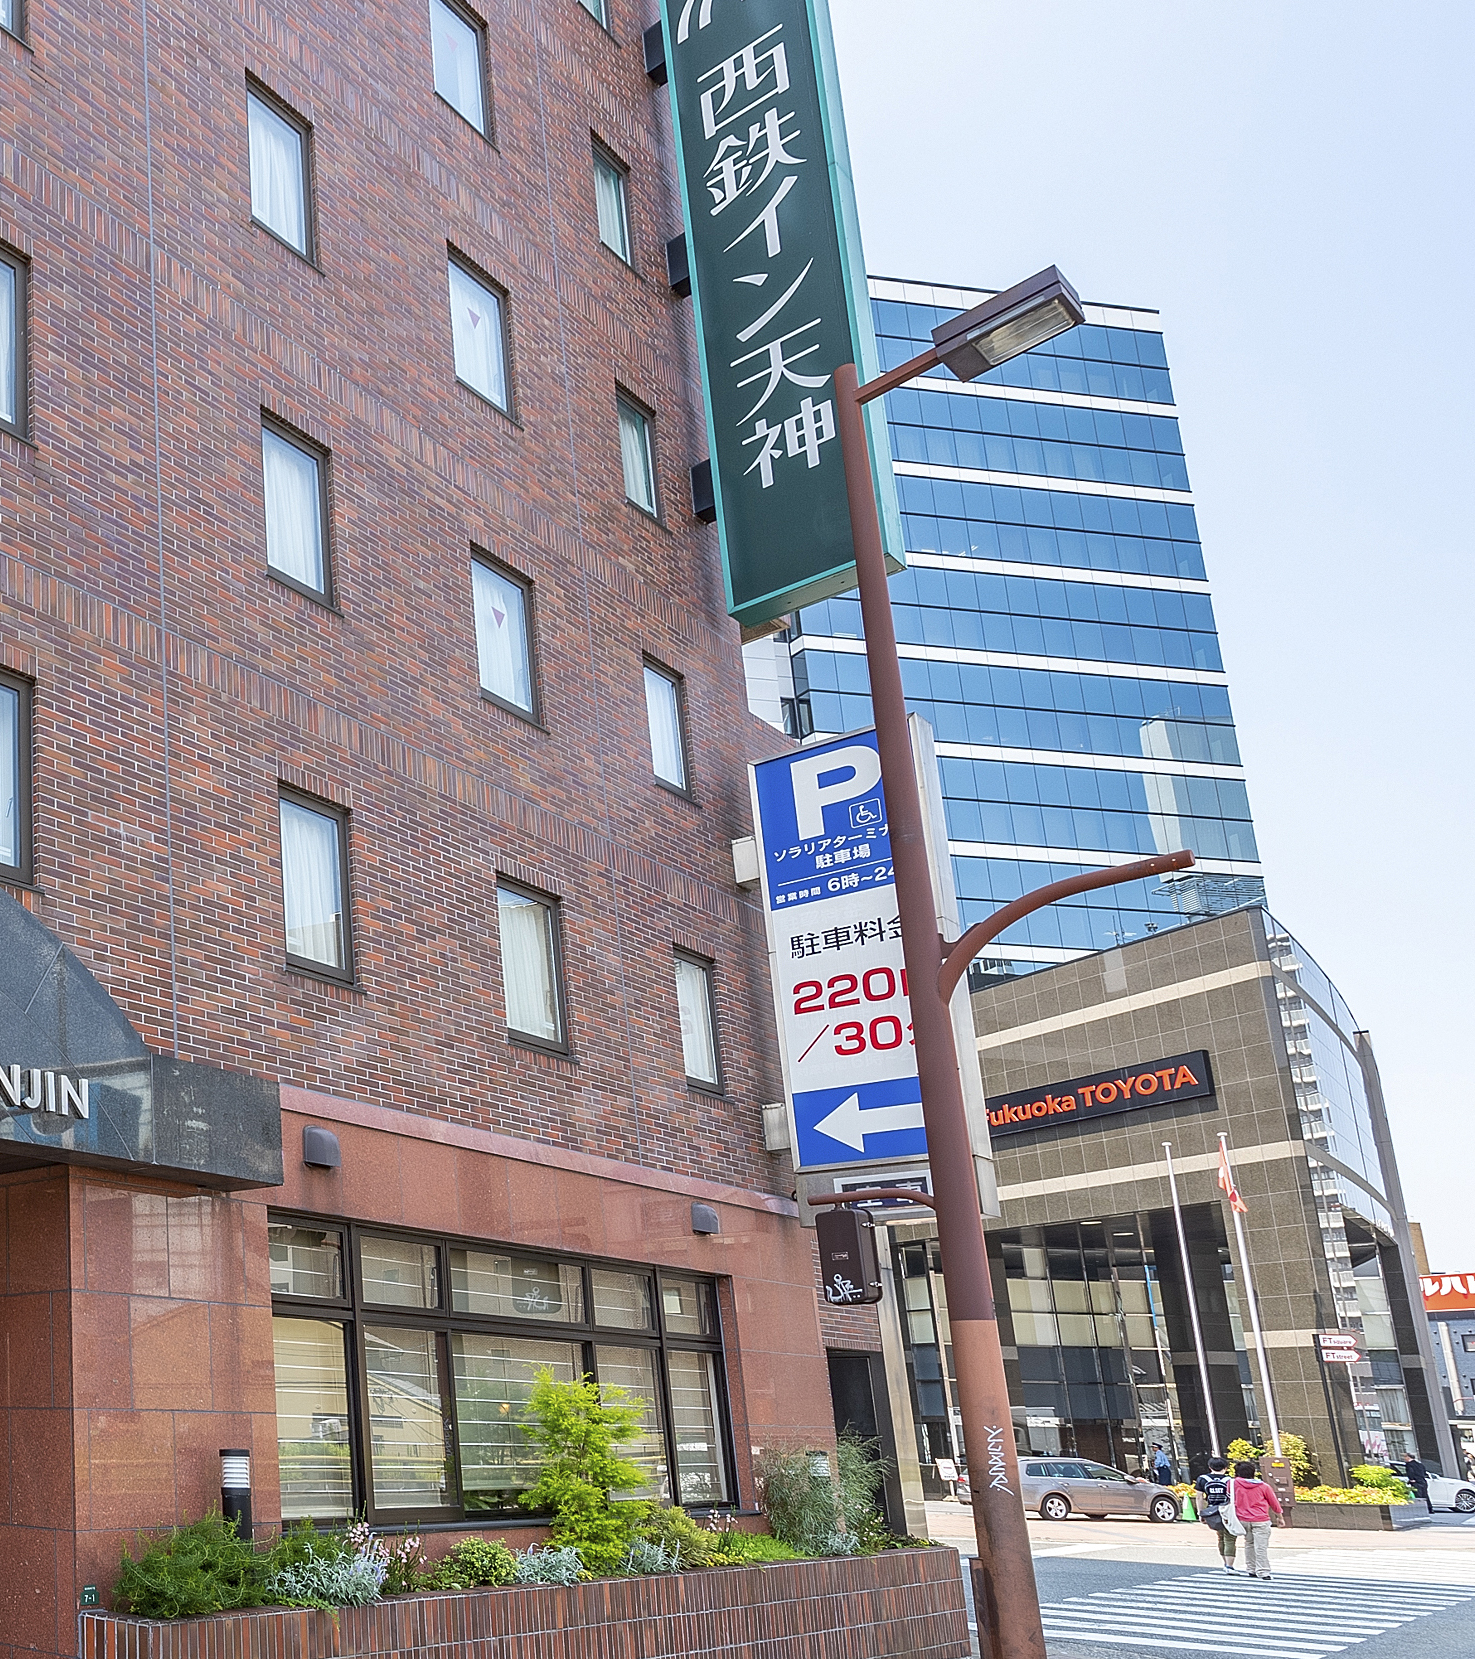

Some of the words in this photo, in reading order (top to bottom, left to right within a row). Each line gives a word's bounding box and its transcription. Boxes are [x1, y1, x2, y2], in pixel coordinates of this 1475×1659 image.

[696, 23, 837, 488] 西鉄イン天神
[790, 746, 882, 841] P
[815, 843, 871, 869] 駐車場
[792, 967, 908, 1015] 220
[797, 1015, 915, 1063] /30
[1077, 1064, 1199, 1107] TOYOTA
